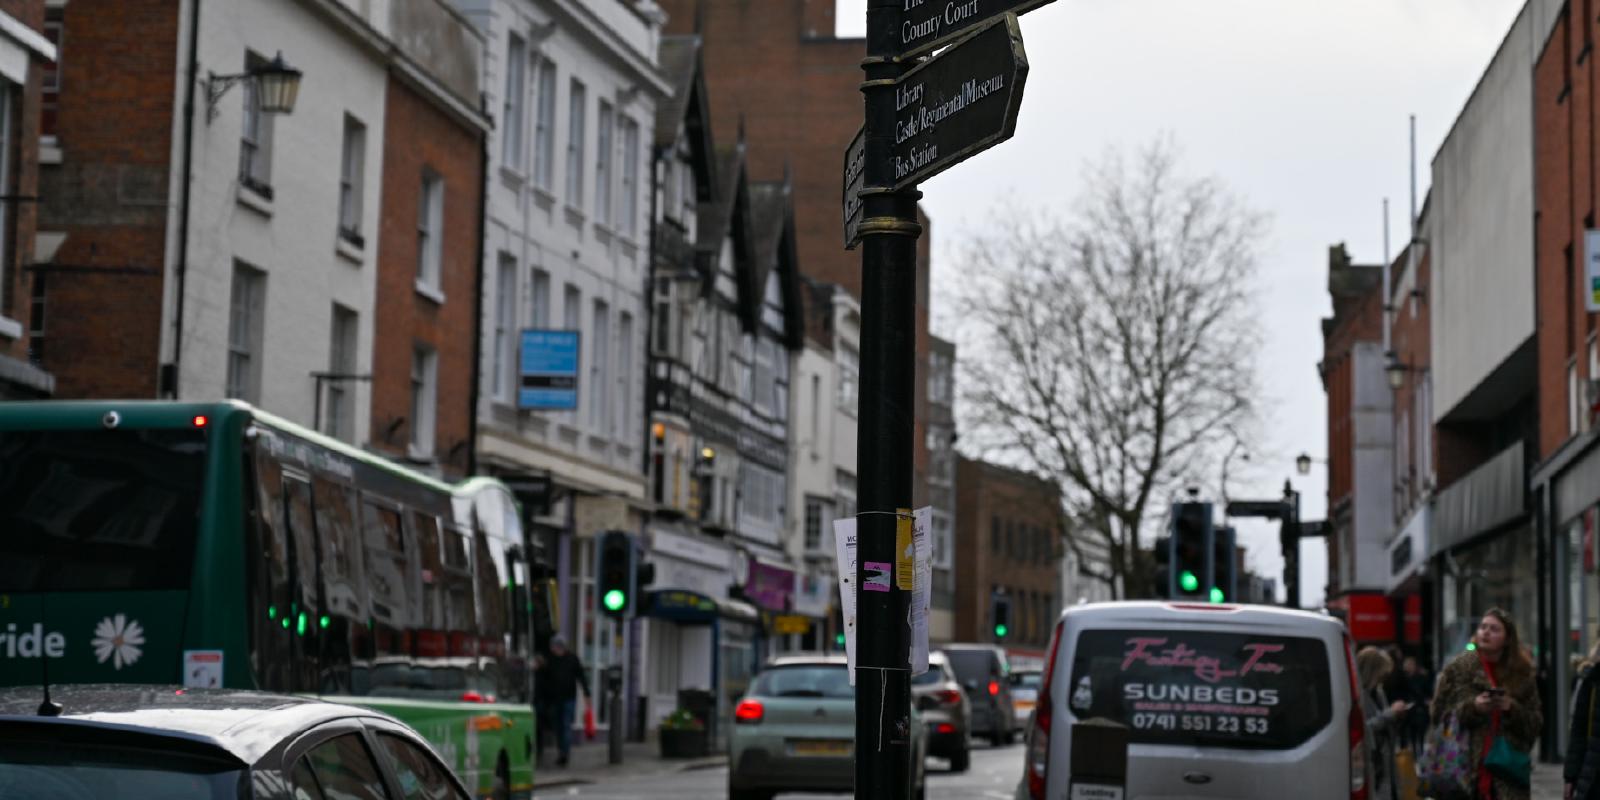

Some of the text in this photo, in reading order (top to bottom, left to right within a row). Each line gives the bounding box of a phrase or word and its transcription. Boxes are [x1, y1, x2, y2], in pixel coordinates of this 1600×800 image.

[902, 0, 978, 43] County Court
[896, 82, 924, 111] Library
[896, 143, 937, 179] Bus Station
[1124, 683, 1279, 705] SUNBEDS
[1133, 712, 1268, 735] 0741 551 23 53
